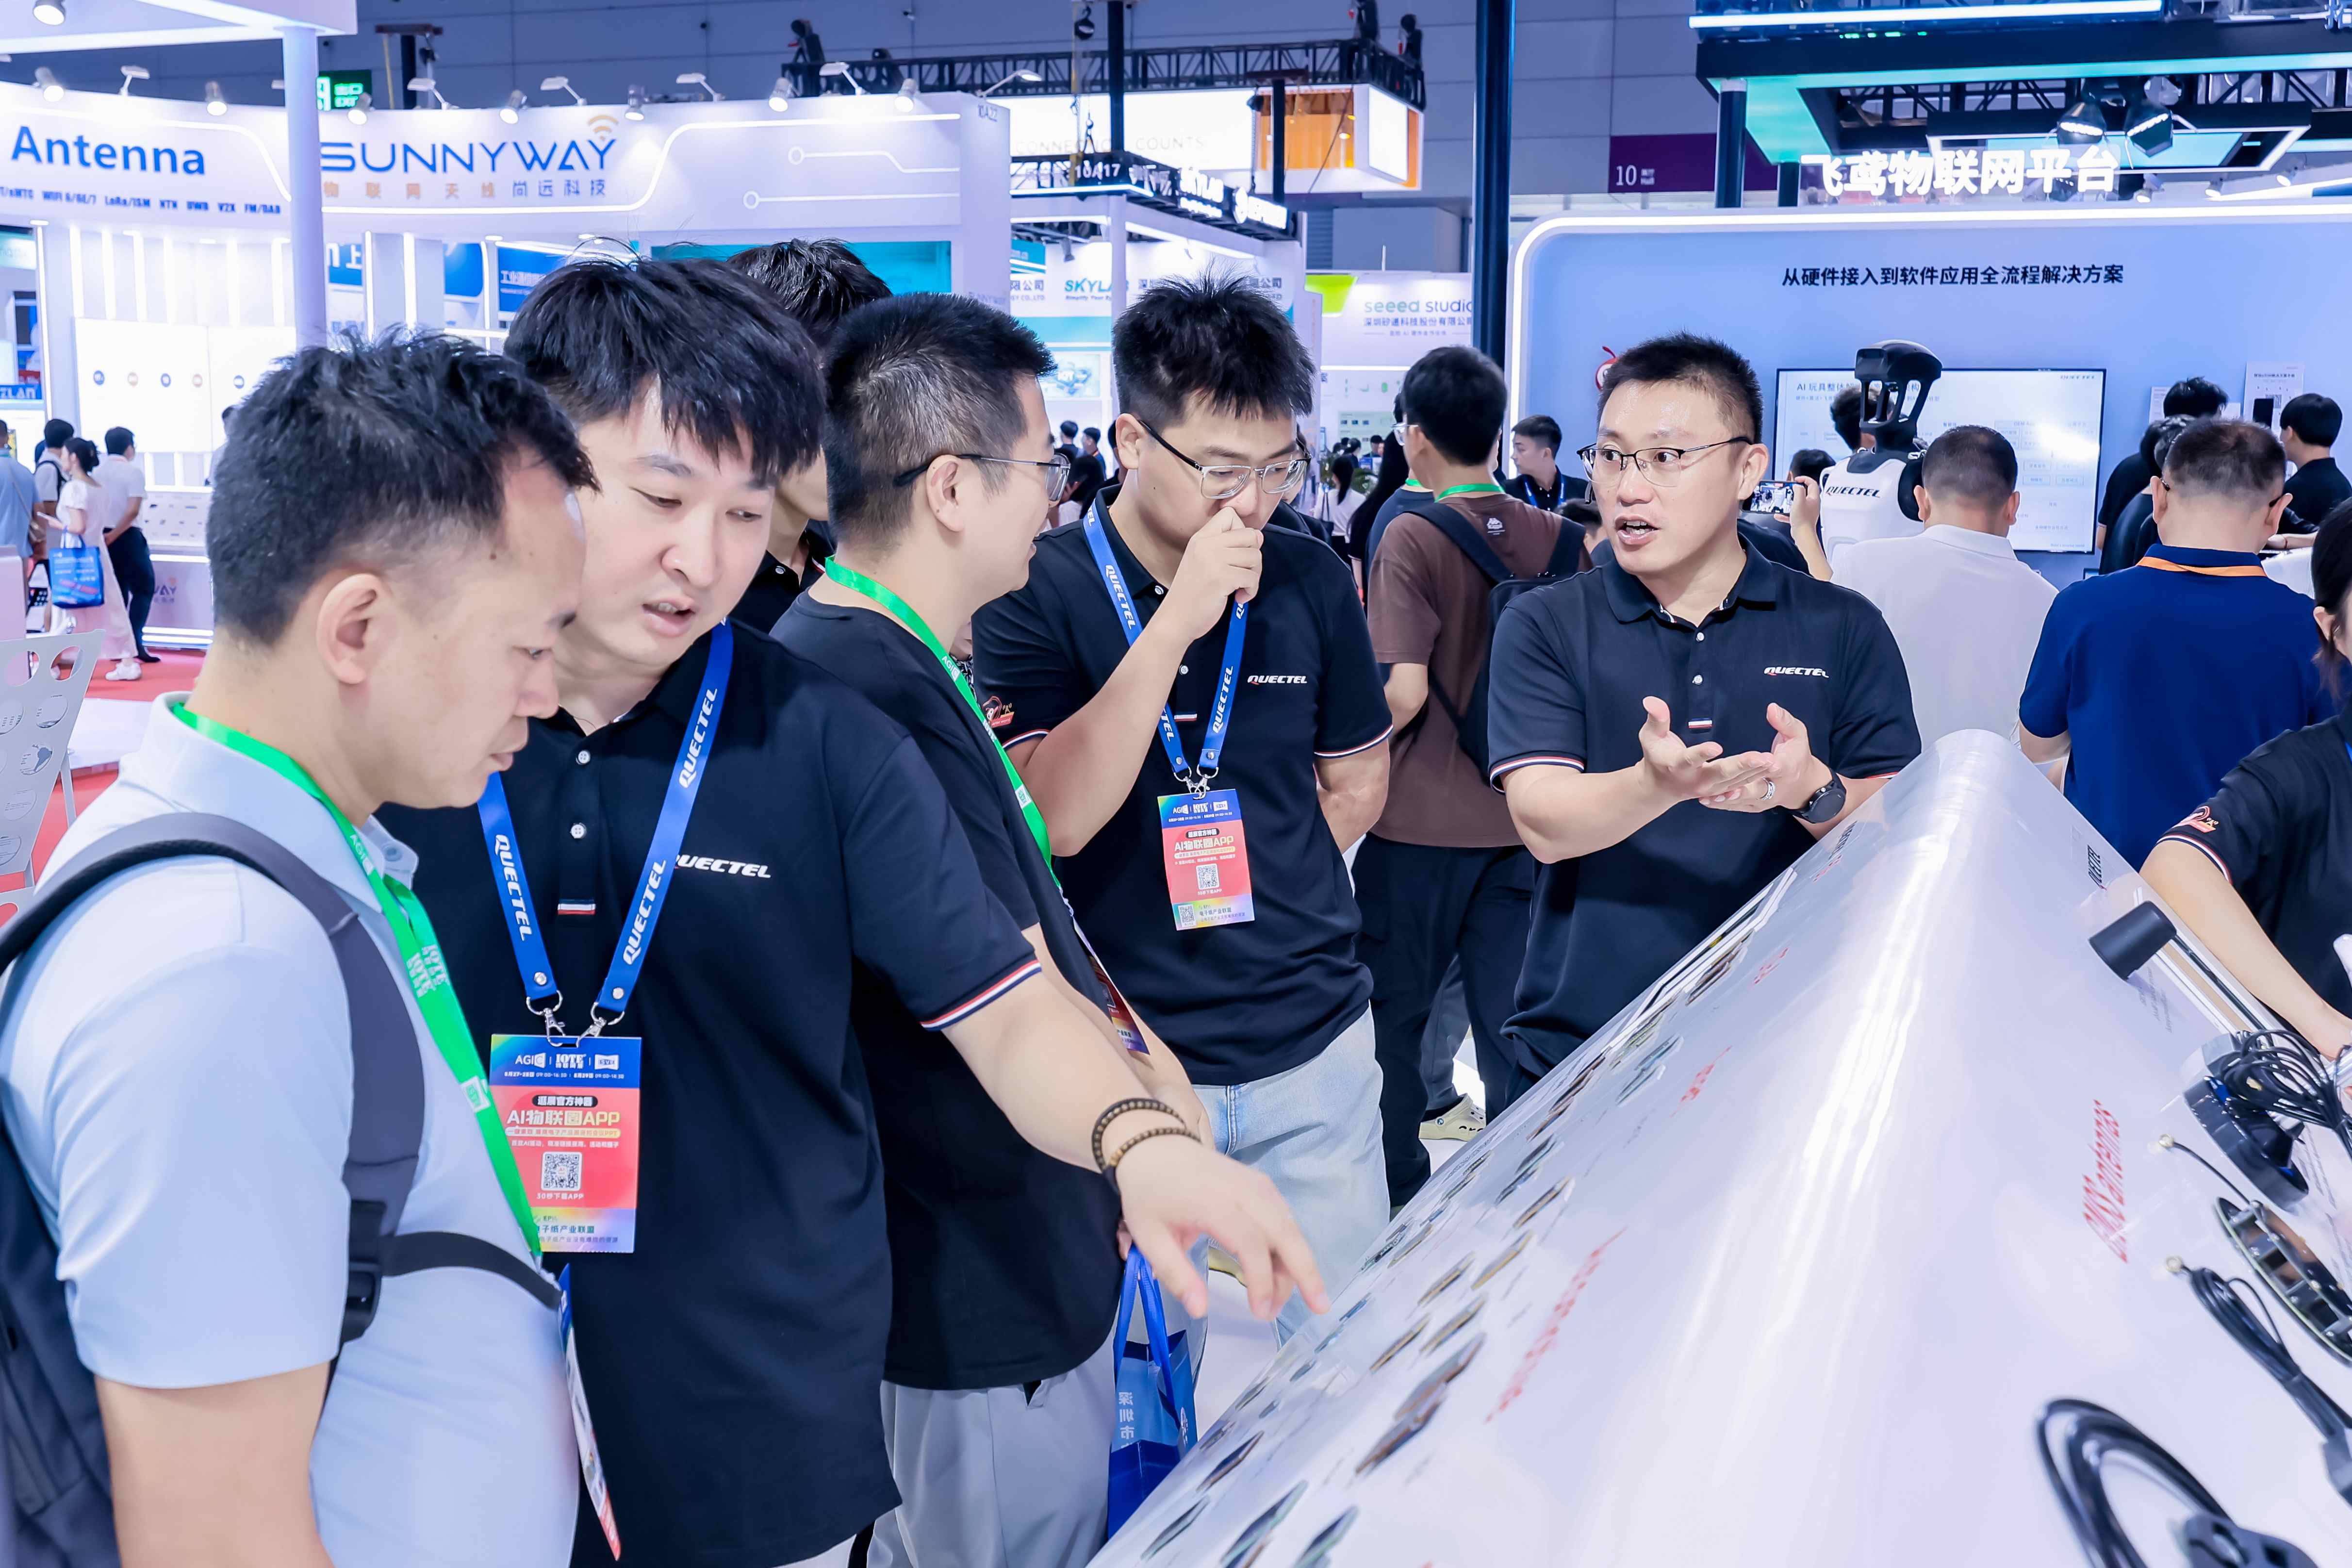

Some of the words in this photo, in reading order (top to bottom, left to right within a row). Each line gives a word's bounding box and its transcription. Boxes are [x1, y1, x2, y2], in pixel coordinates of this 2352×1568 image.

[12, 126, 205, 175] Antenna
[321, 138, 616, 172] SUNNYWAY
[1616, 165, 1637, 186] 10
[1801, 145, 2119, 196] 飞鸢物联网平台
[512, 179, 606, 197] 尚远科技
[1782, 264, 2124, 286] 从硬件接入到软件应用全流程解决方案
[1365, 299, 1420, 313] seeed
[1826, 486, 1881, 498] QUECTEL
[1105, 565, 1136, 630] QUECTEL
[1247, 675, 1307, 685] QUECTEL
[1763, 666, 1830, 678] QUECTEL
[1213, 666, 1233, 733] QUECTEL
[678, 688, 718, 788] QUECTEL
[494, 834, 533, 941] QUECTEL
[623, 859, 667, 965] QUECTEL
